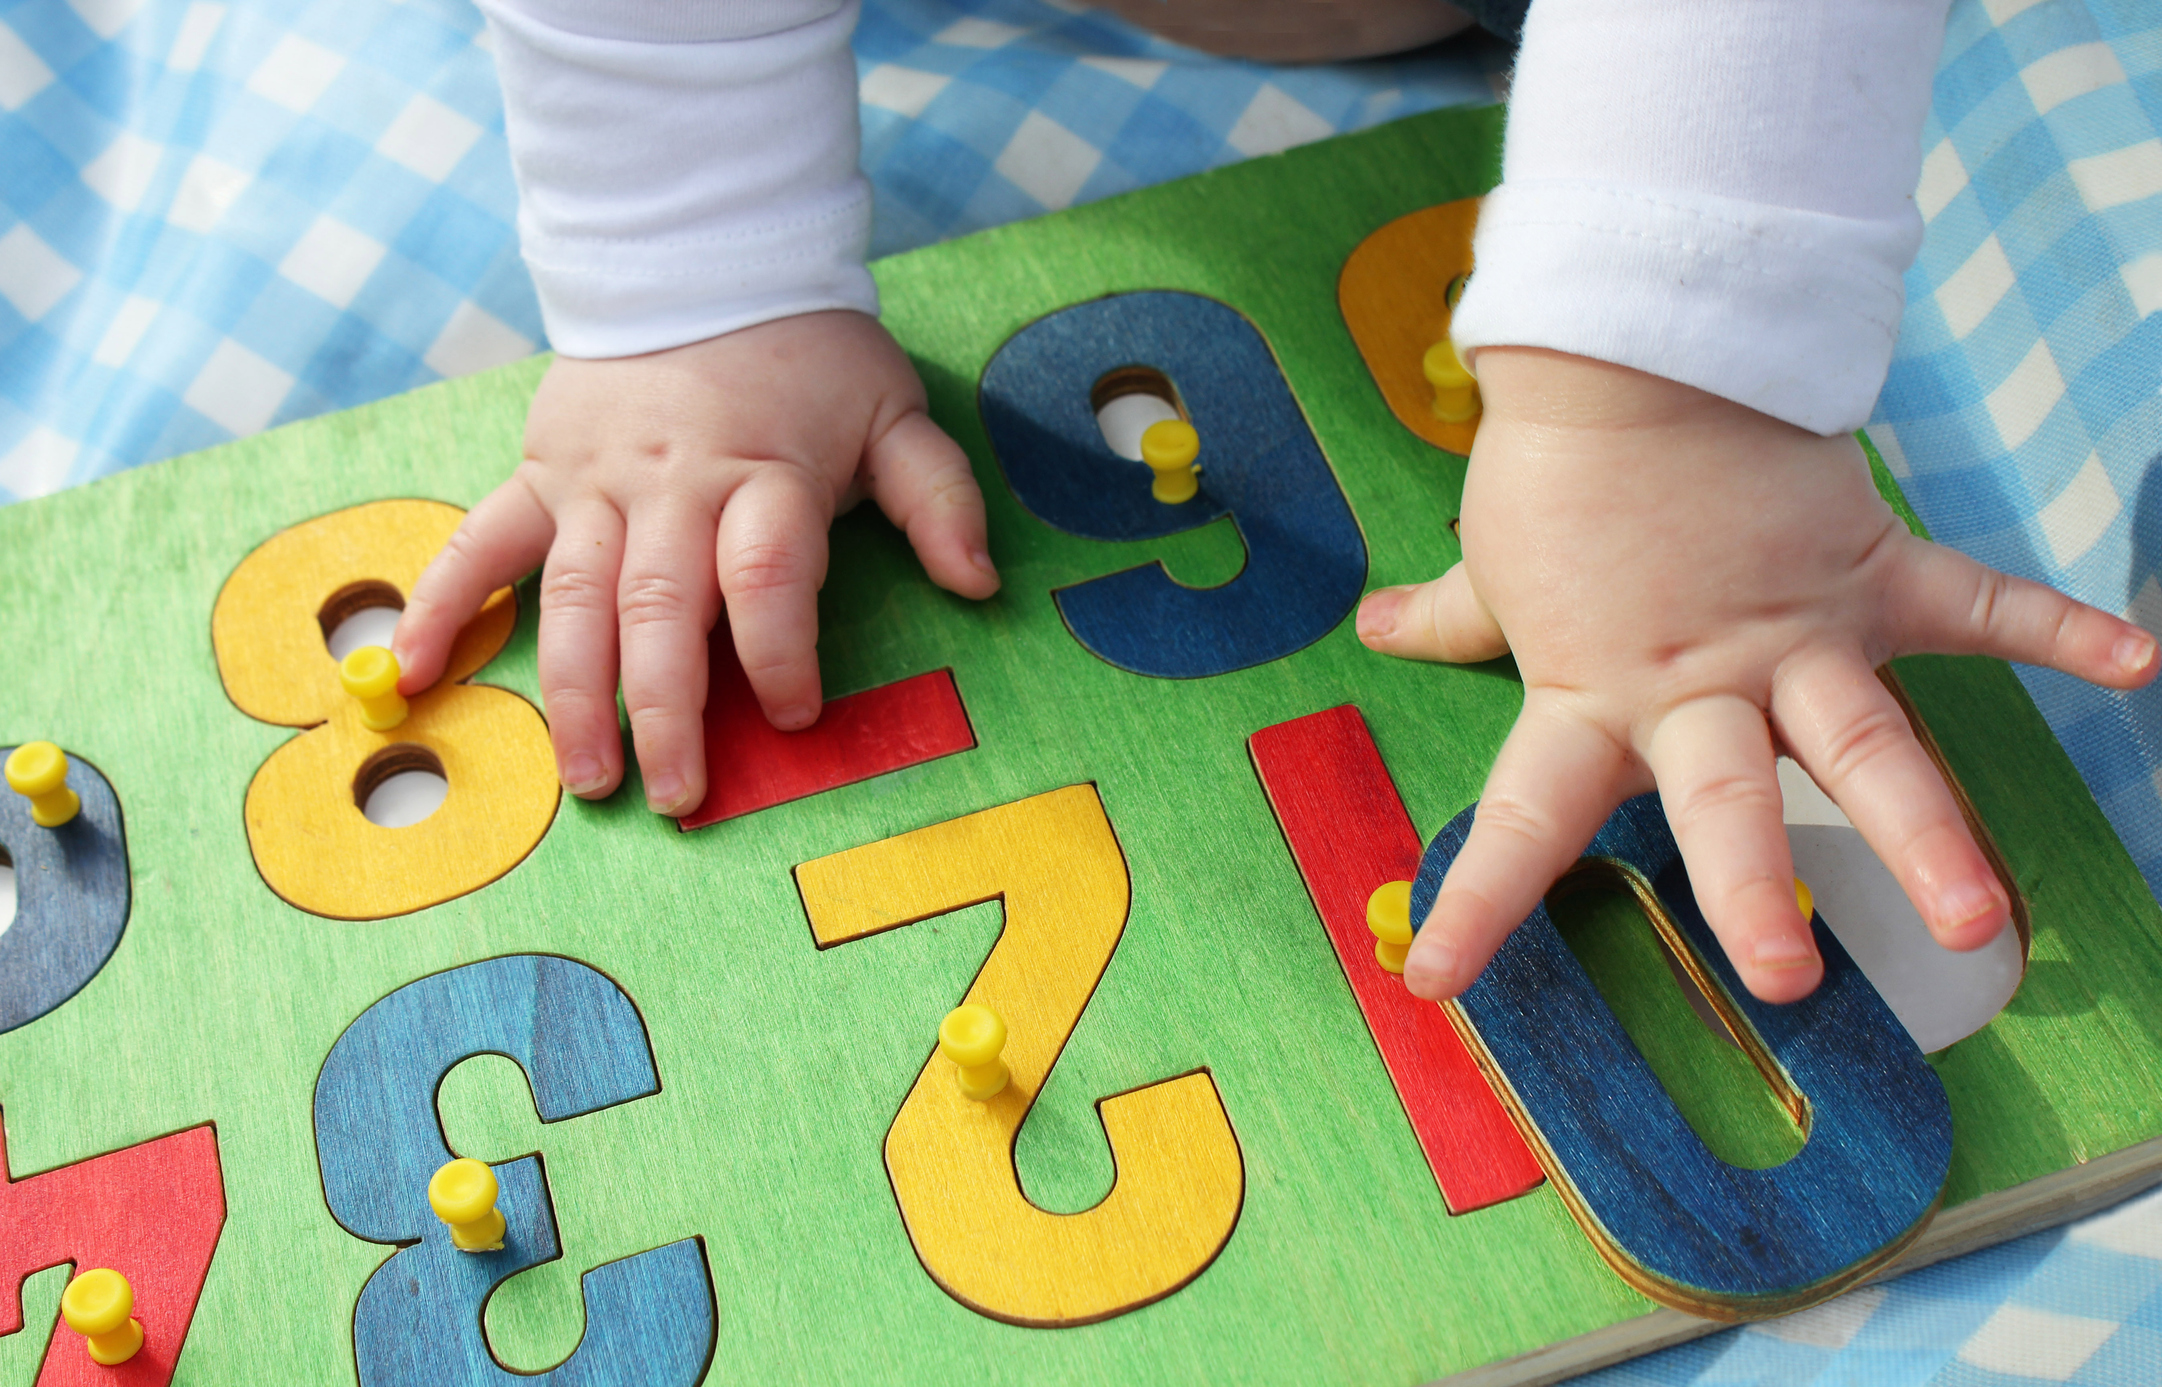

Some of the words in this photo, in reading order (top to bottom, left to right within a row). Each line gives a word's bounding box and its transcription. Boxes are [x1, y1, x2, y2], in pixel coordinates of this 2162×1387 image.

[212, 499, 560, 919] 8
[314, 954, 719, 1387] 3
[795, 783, 1245, 1326] 2
